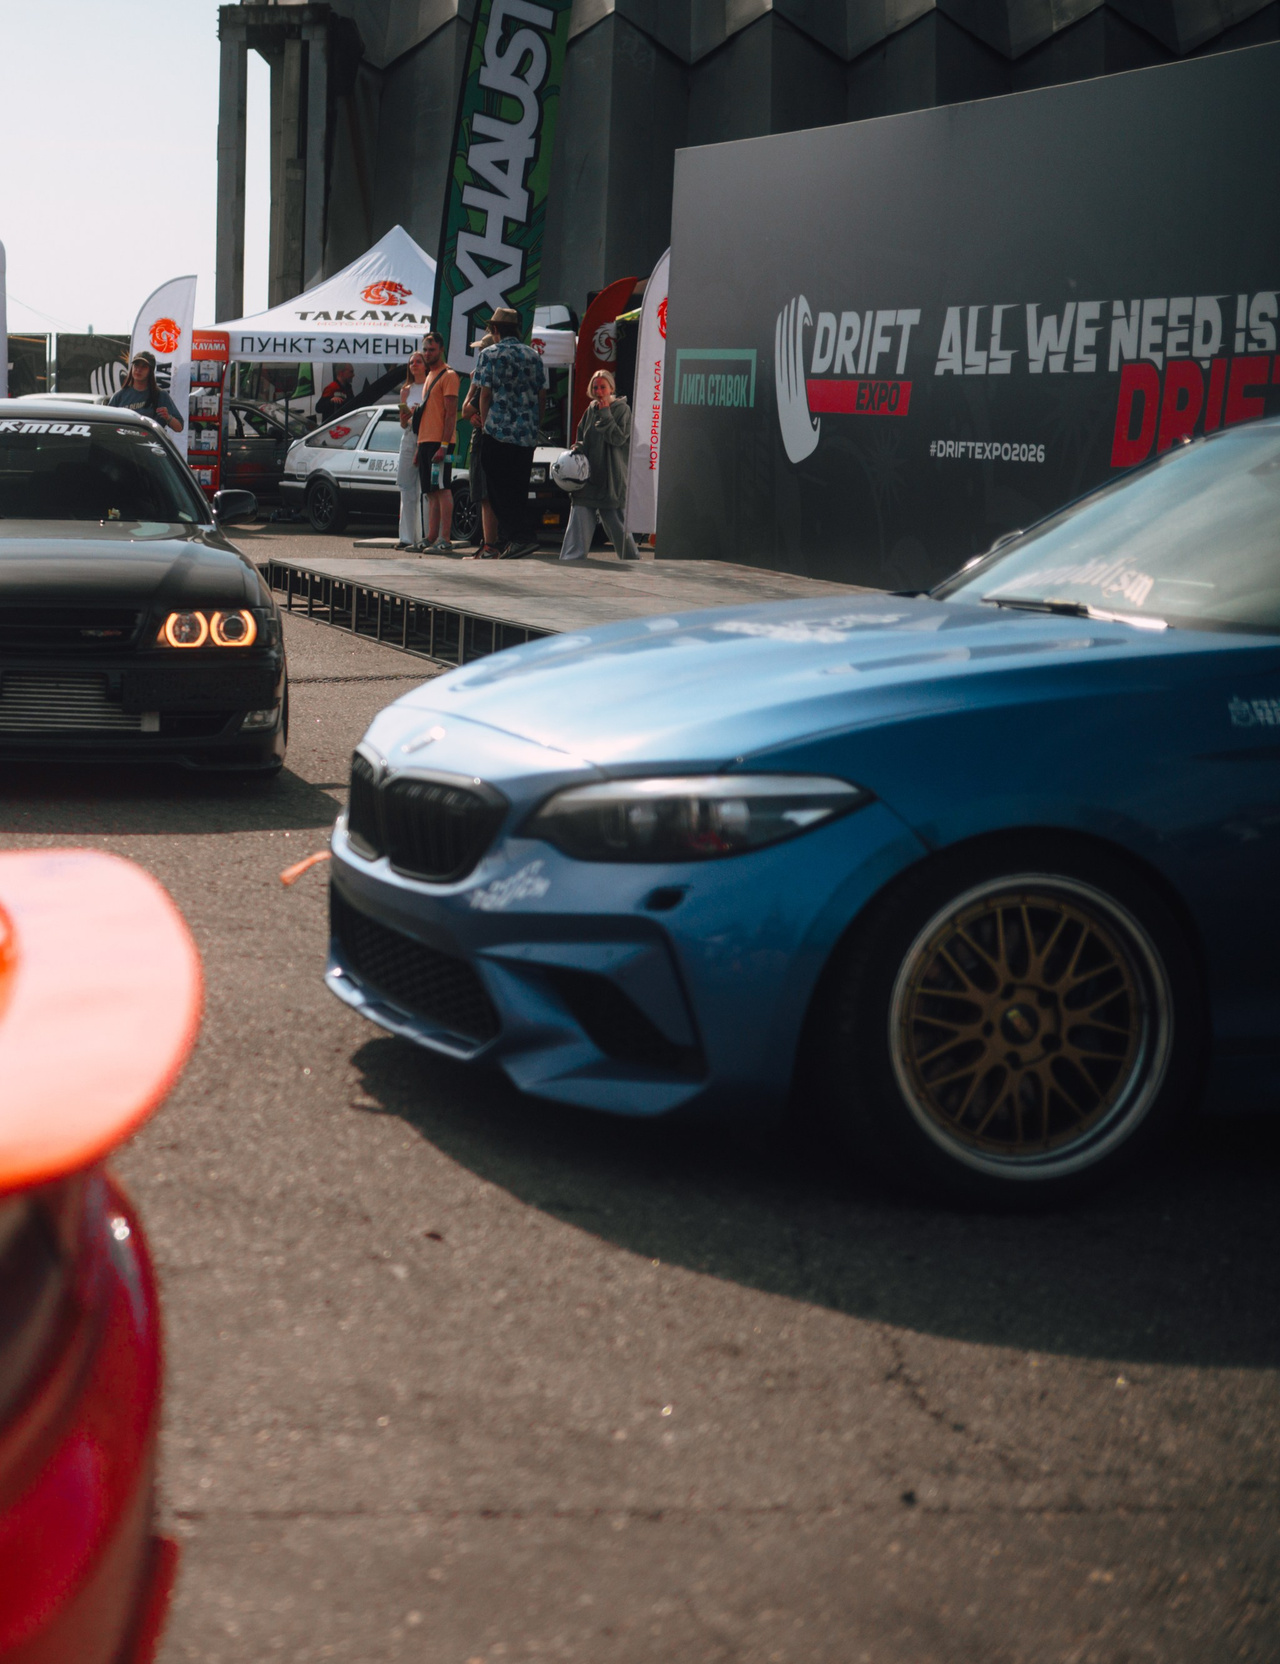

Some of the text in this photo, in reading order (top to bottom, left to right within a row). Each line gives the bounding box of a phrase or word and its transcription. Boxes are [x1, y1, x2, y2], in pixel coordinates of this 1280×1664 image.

[240, 336, 419, 354] ПУНКТ ЗАМЕНЫ
[811, 308, 921, 375] DRIFT
[934, 291, 1280, 376] ALL WE NEED IS
[648, 360, 662, 471] МОТОРНЫЕ МАСЛА
[680, 373, 749, 408] ЛИГА СТАВОК
[855, 382, 901, 413] EXPO
[1110, 355, 1280, 468] DRIF
[929, 440, 1046, 463] #DRIFTEXPO2026
